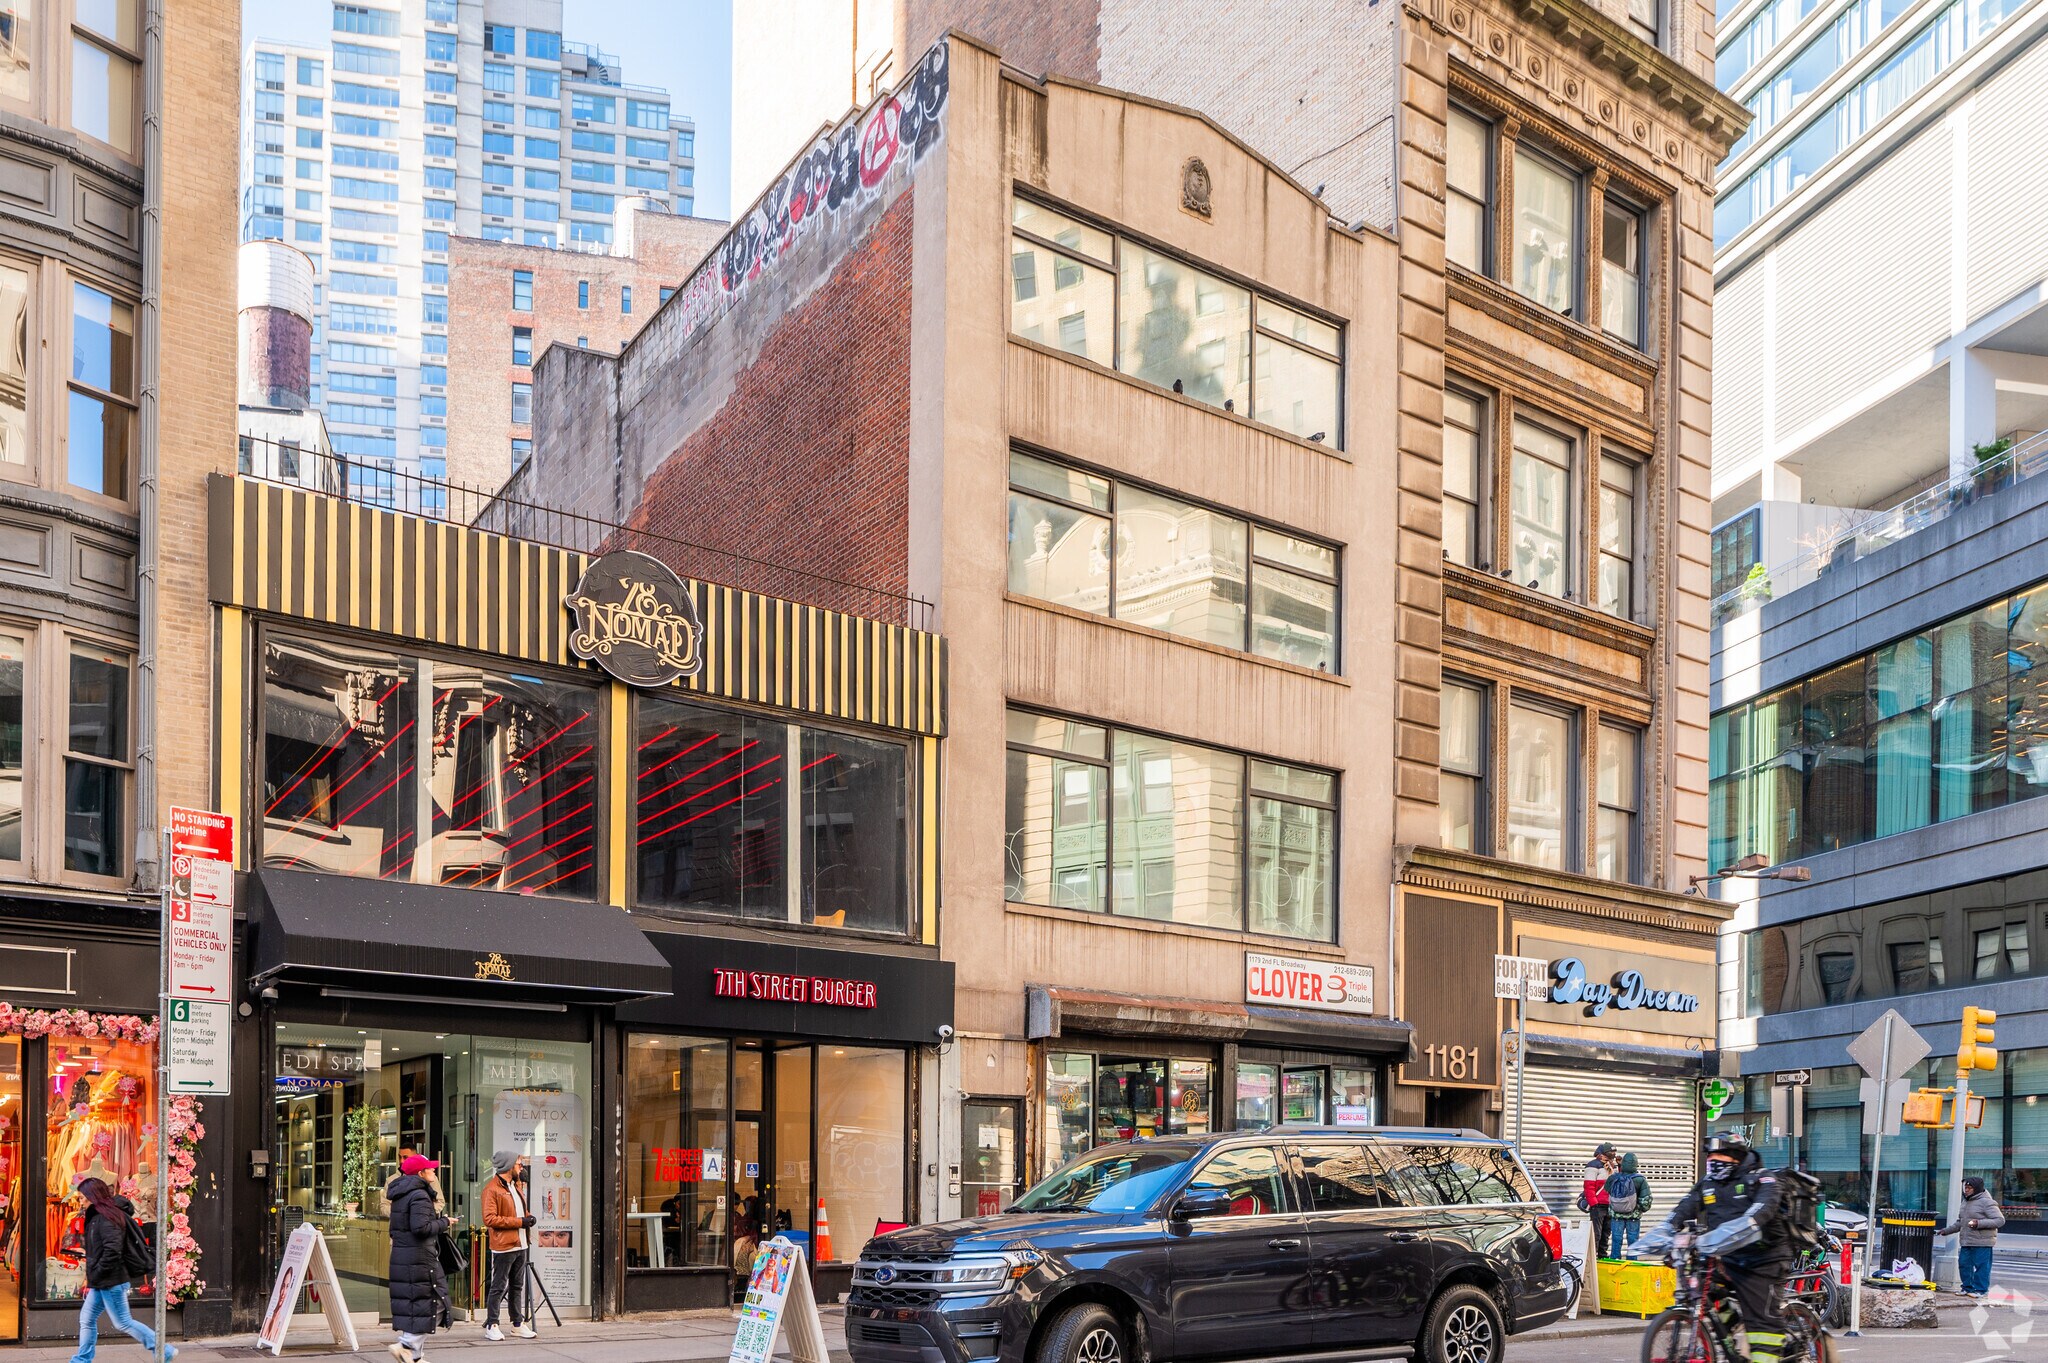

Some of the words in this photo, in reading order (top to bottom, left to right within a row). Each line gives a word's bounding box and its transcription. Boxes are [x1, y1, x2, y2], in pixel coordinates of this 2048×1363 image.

[575, 597, 697, 669] NOMAD
[174, 812, 186, 822] NO
[188, 814, 226, 829] STANDING
[174, 824, 207, 837] Anytime
[193, 873, 208, 881] Friday
[194, 867, 221, 875] Wednesday
[208, 882, 219, 890] 6am
[176, 901, 187, 920] 3
[193, 911, 214, 919] metered
[174, 927, 220, 940] COMMERCIAL
[174, 938, 208, 950] VEHICLES
[209, 942, 227, 952] ONLY
[173, 951, 194, 961] Monday
[199, 954, 215, 963] Friday
[1262, 957, 1272, 965] 2nd
[1273, 958, 1280, 966] FL
[1281, 959, 1307, 970] Broadway
[174, 960, 186, 968] 7am
[1496, 959, 1518, 979] FOR
[1520, 961, 1547, 981] RENT
[1334, 966, 1372, 977] 212-689-2090
[714, 968, 748, 997] 7TH
[750, 971, 810, 1003] STREET
[811, 977, 878, 1008] BURGER
[1248, 967, 1324, 1003] CLOVER
[1349, 981, 1368, 991] Triple
[1496, 982, 1547, 998] 646-3-5399
[1552, 957, 1614, 1017] Day
[1617, 969, 1700, 1012] Dream
[1348, 993, 1372, 1004] Double
[174, 1001, 186, 1020] 6
[172, 1027, 195, 1036] Monday
[200, 1028, 217, 1038] Friday
[172, 1036, 186, 1044] 6pm
[190, 1037, 214, 1046] Midnight
[172, 1047, 198, 1057] Saturday
[172, 1056, 186, 1064] 8am
[190, 1058, 214, 1067] Midnight
[282, 1053, 320, 1070] EDI
[1424, 1043, 1479, 1080] 1181
[490, 1065, 541, 1080] MEDI
[287, 1079, 343, 1089] NOMAD
[1338, 1113, 1366, 1121] PERFUME
[668, 1148, 704, 1165] STREET
[707, 1157, 719, 1173] A
[662, 1166, 703, 1183] BURGER
